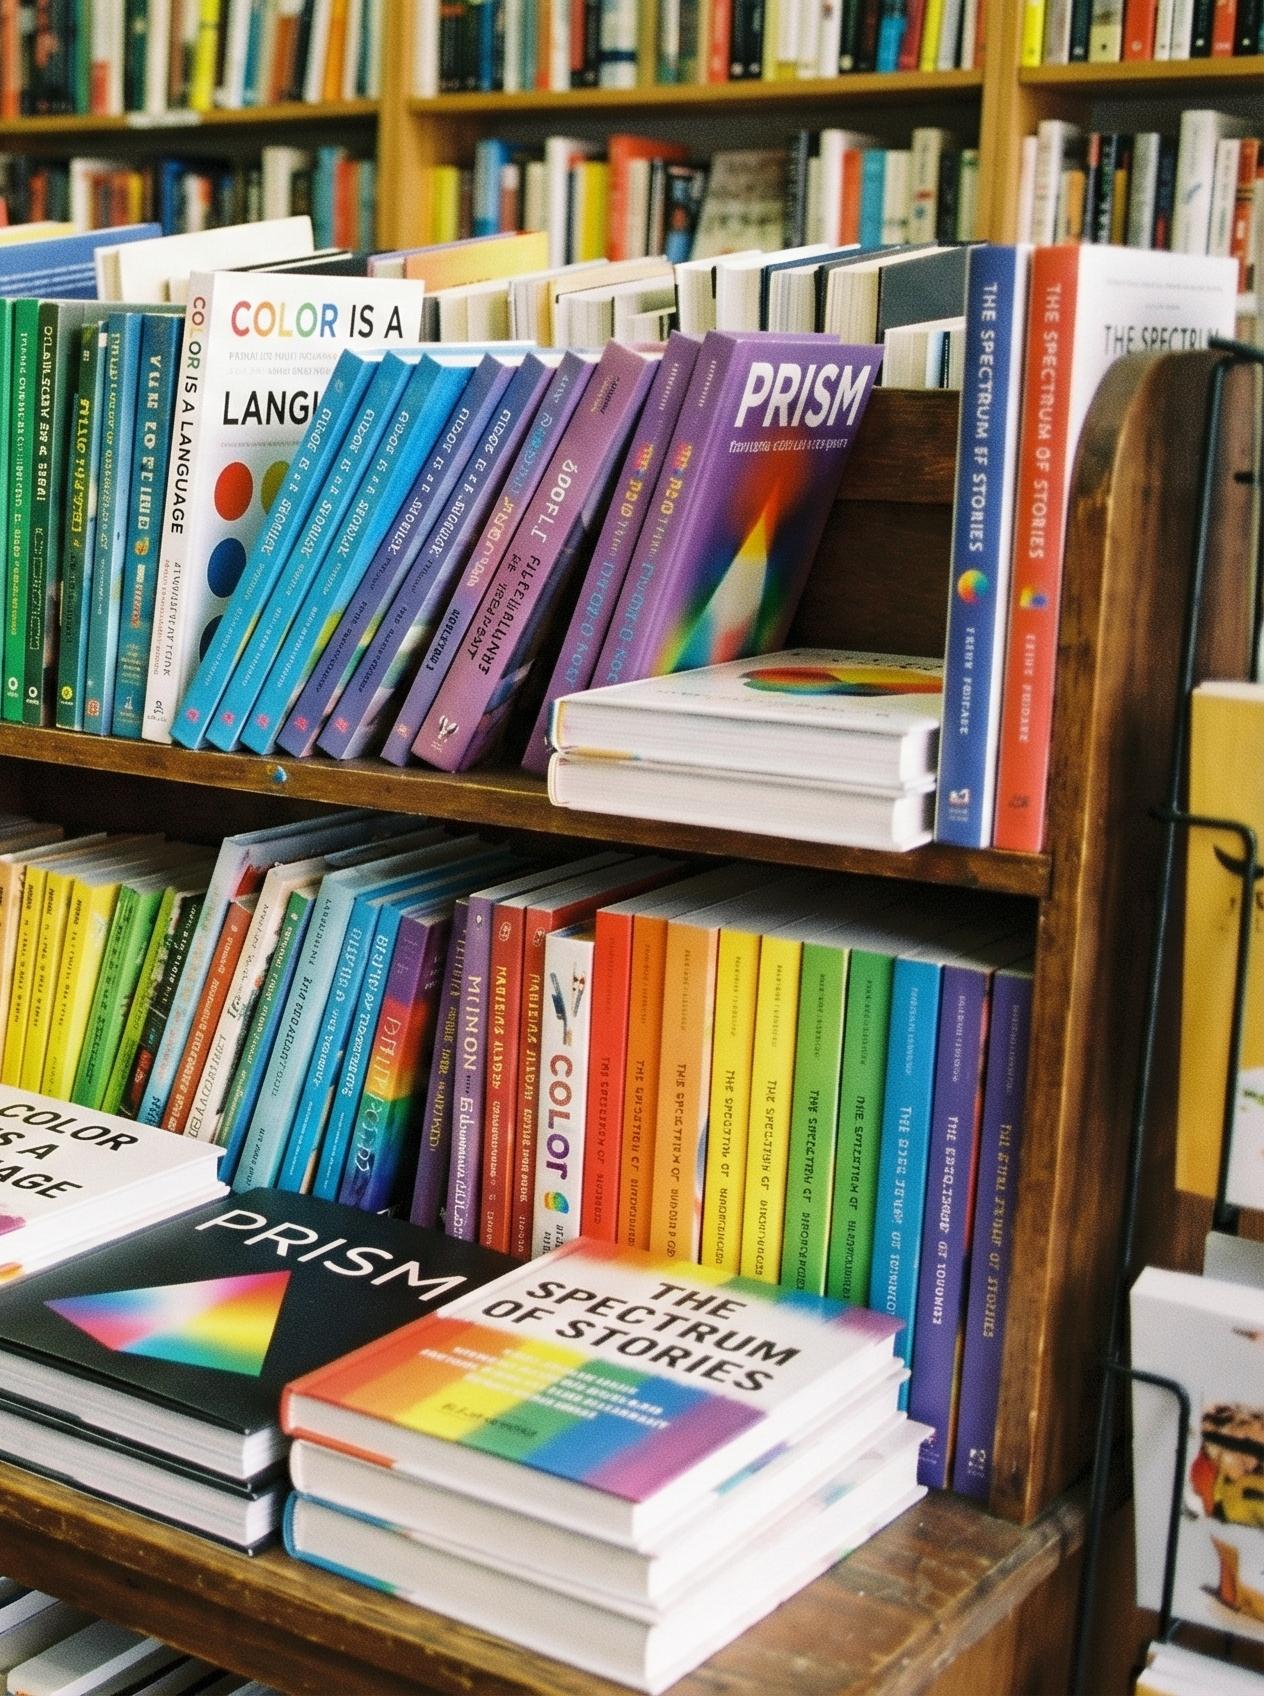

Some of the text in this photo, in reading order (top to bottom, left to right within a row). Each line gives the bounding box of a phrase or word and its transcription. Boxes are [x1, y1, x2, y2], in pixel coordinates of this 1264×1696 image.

[230, 300, 404, 339] COLOR IS A
[980, 282, 998, 321] THE
[1043, 283, 1062, 323] THE
[171, 296, 207, 535] COLOR IS A LANGUAGE
[733, 361, 872, 428] PRISM
[976, 329, 996, 438] SPECTRUM
[1038, 330, 1059, 440] SPECTRUM
[969, 472, 988, 552] STORIES
[1029, 480, 1049, 560] STORIES
[18, 1143, 61, 1160] A
[194, 1208, 469, 1301] PRISM
[525, 1280, 802, 1368] SPECTRUM
[648, 1282, 748, 1321] THE
[481, 1299, 556, 1326] OF
[555, 1316, 775, 1393] STORIES
